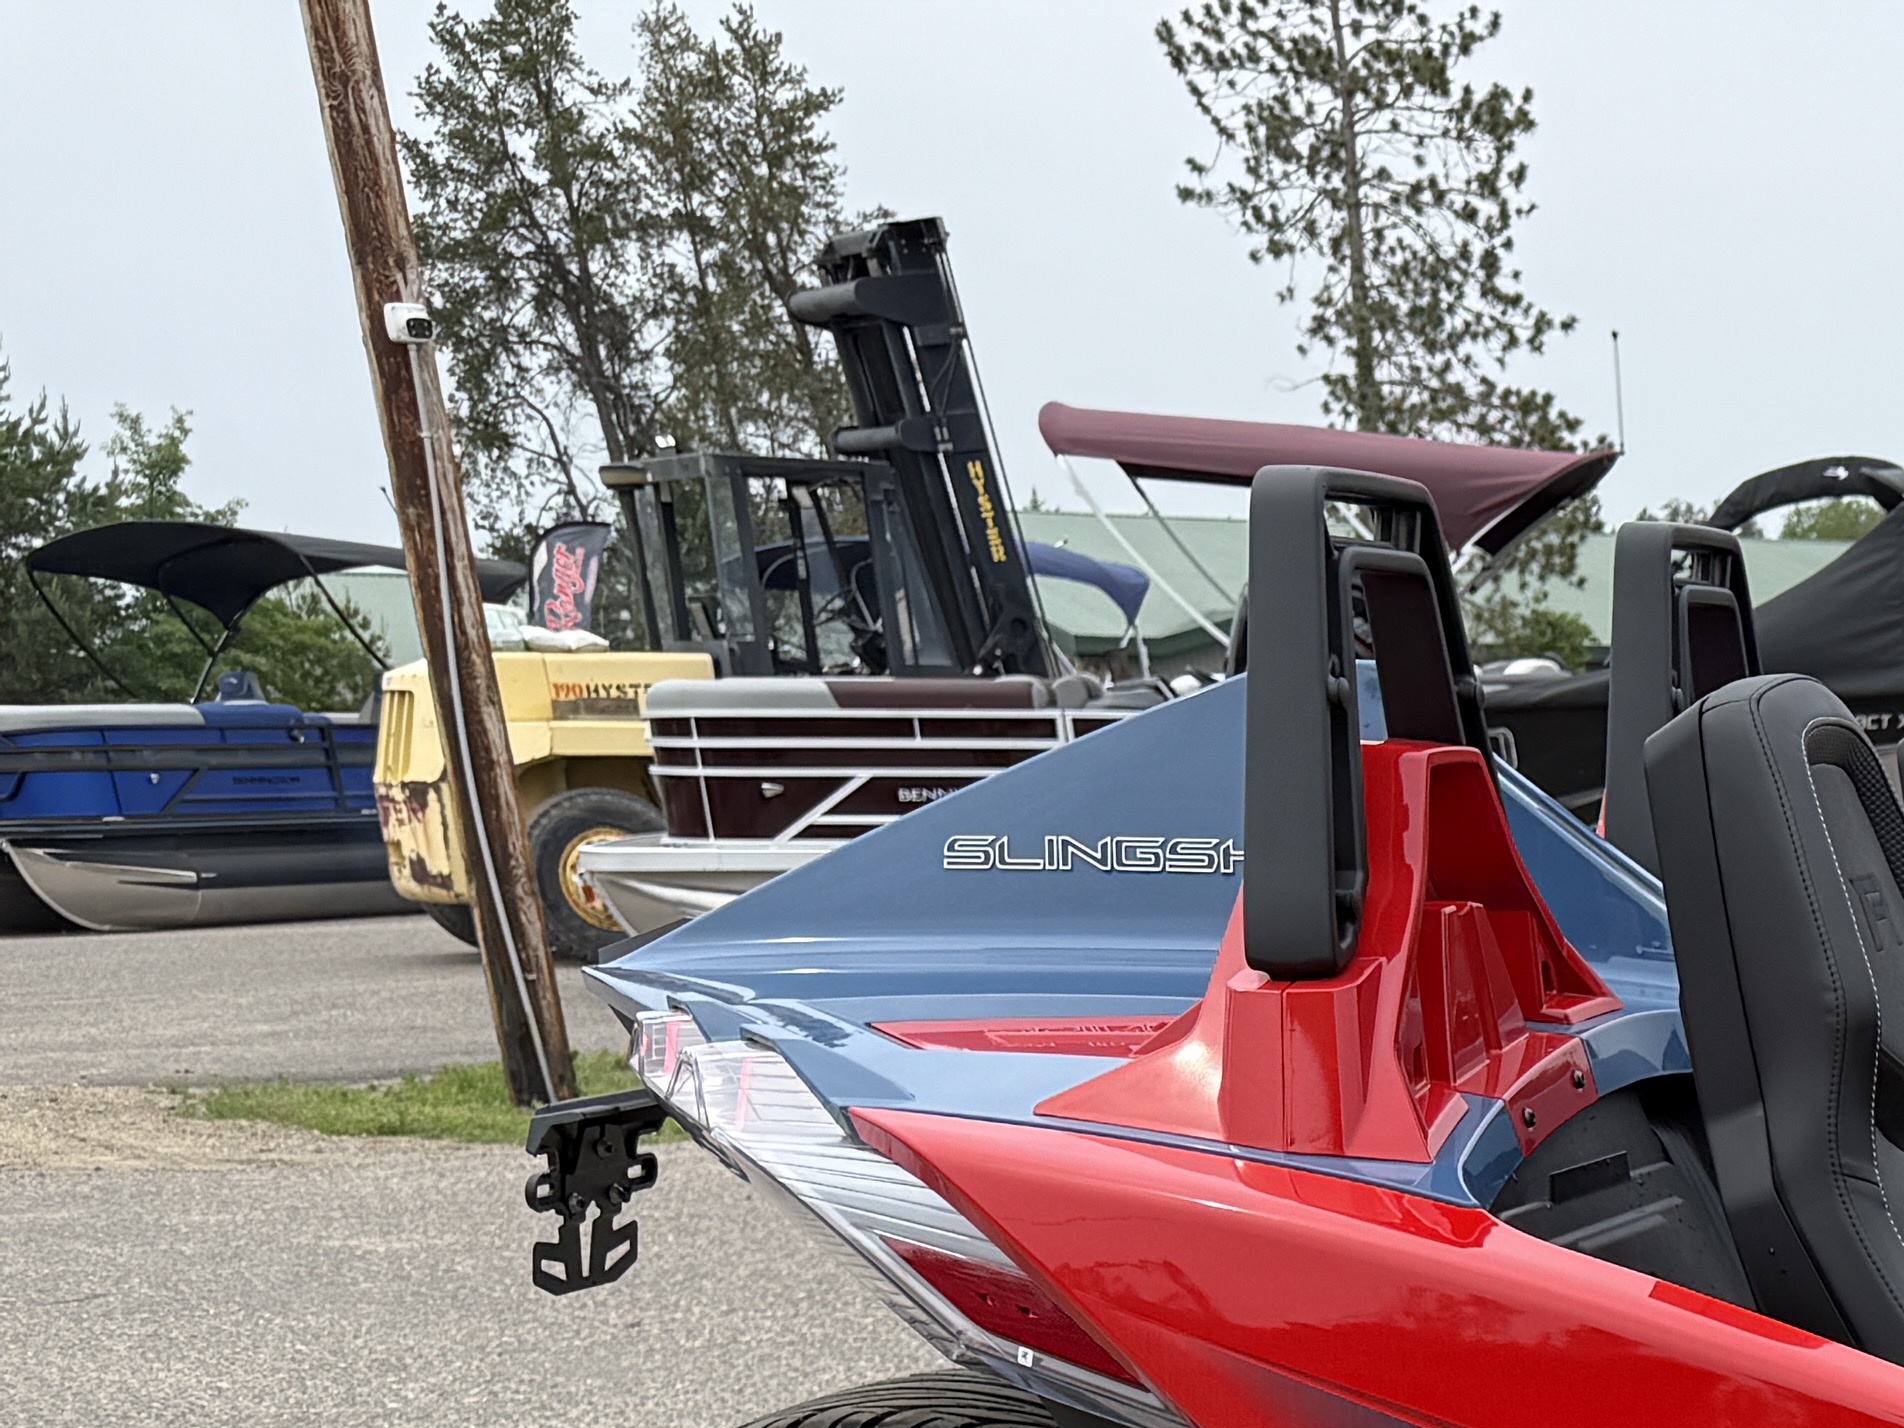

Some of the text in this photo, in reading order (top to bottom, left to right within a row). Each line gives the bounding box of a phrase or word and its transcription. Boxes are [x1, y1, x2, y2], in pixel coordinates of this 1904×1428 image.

[967, 460, 1007, 562] HYSTER
[585, 682, 653, 700] HYST
[943, 835, 1245, 873] SLINGSH
